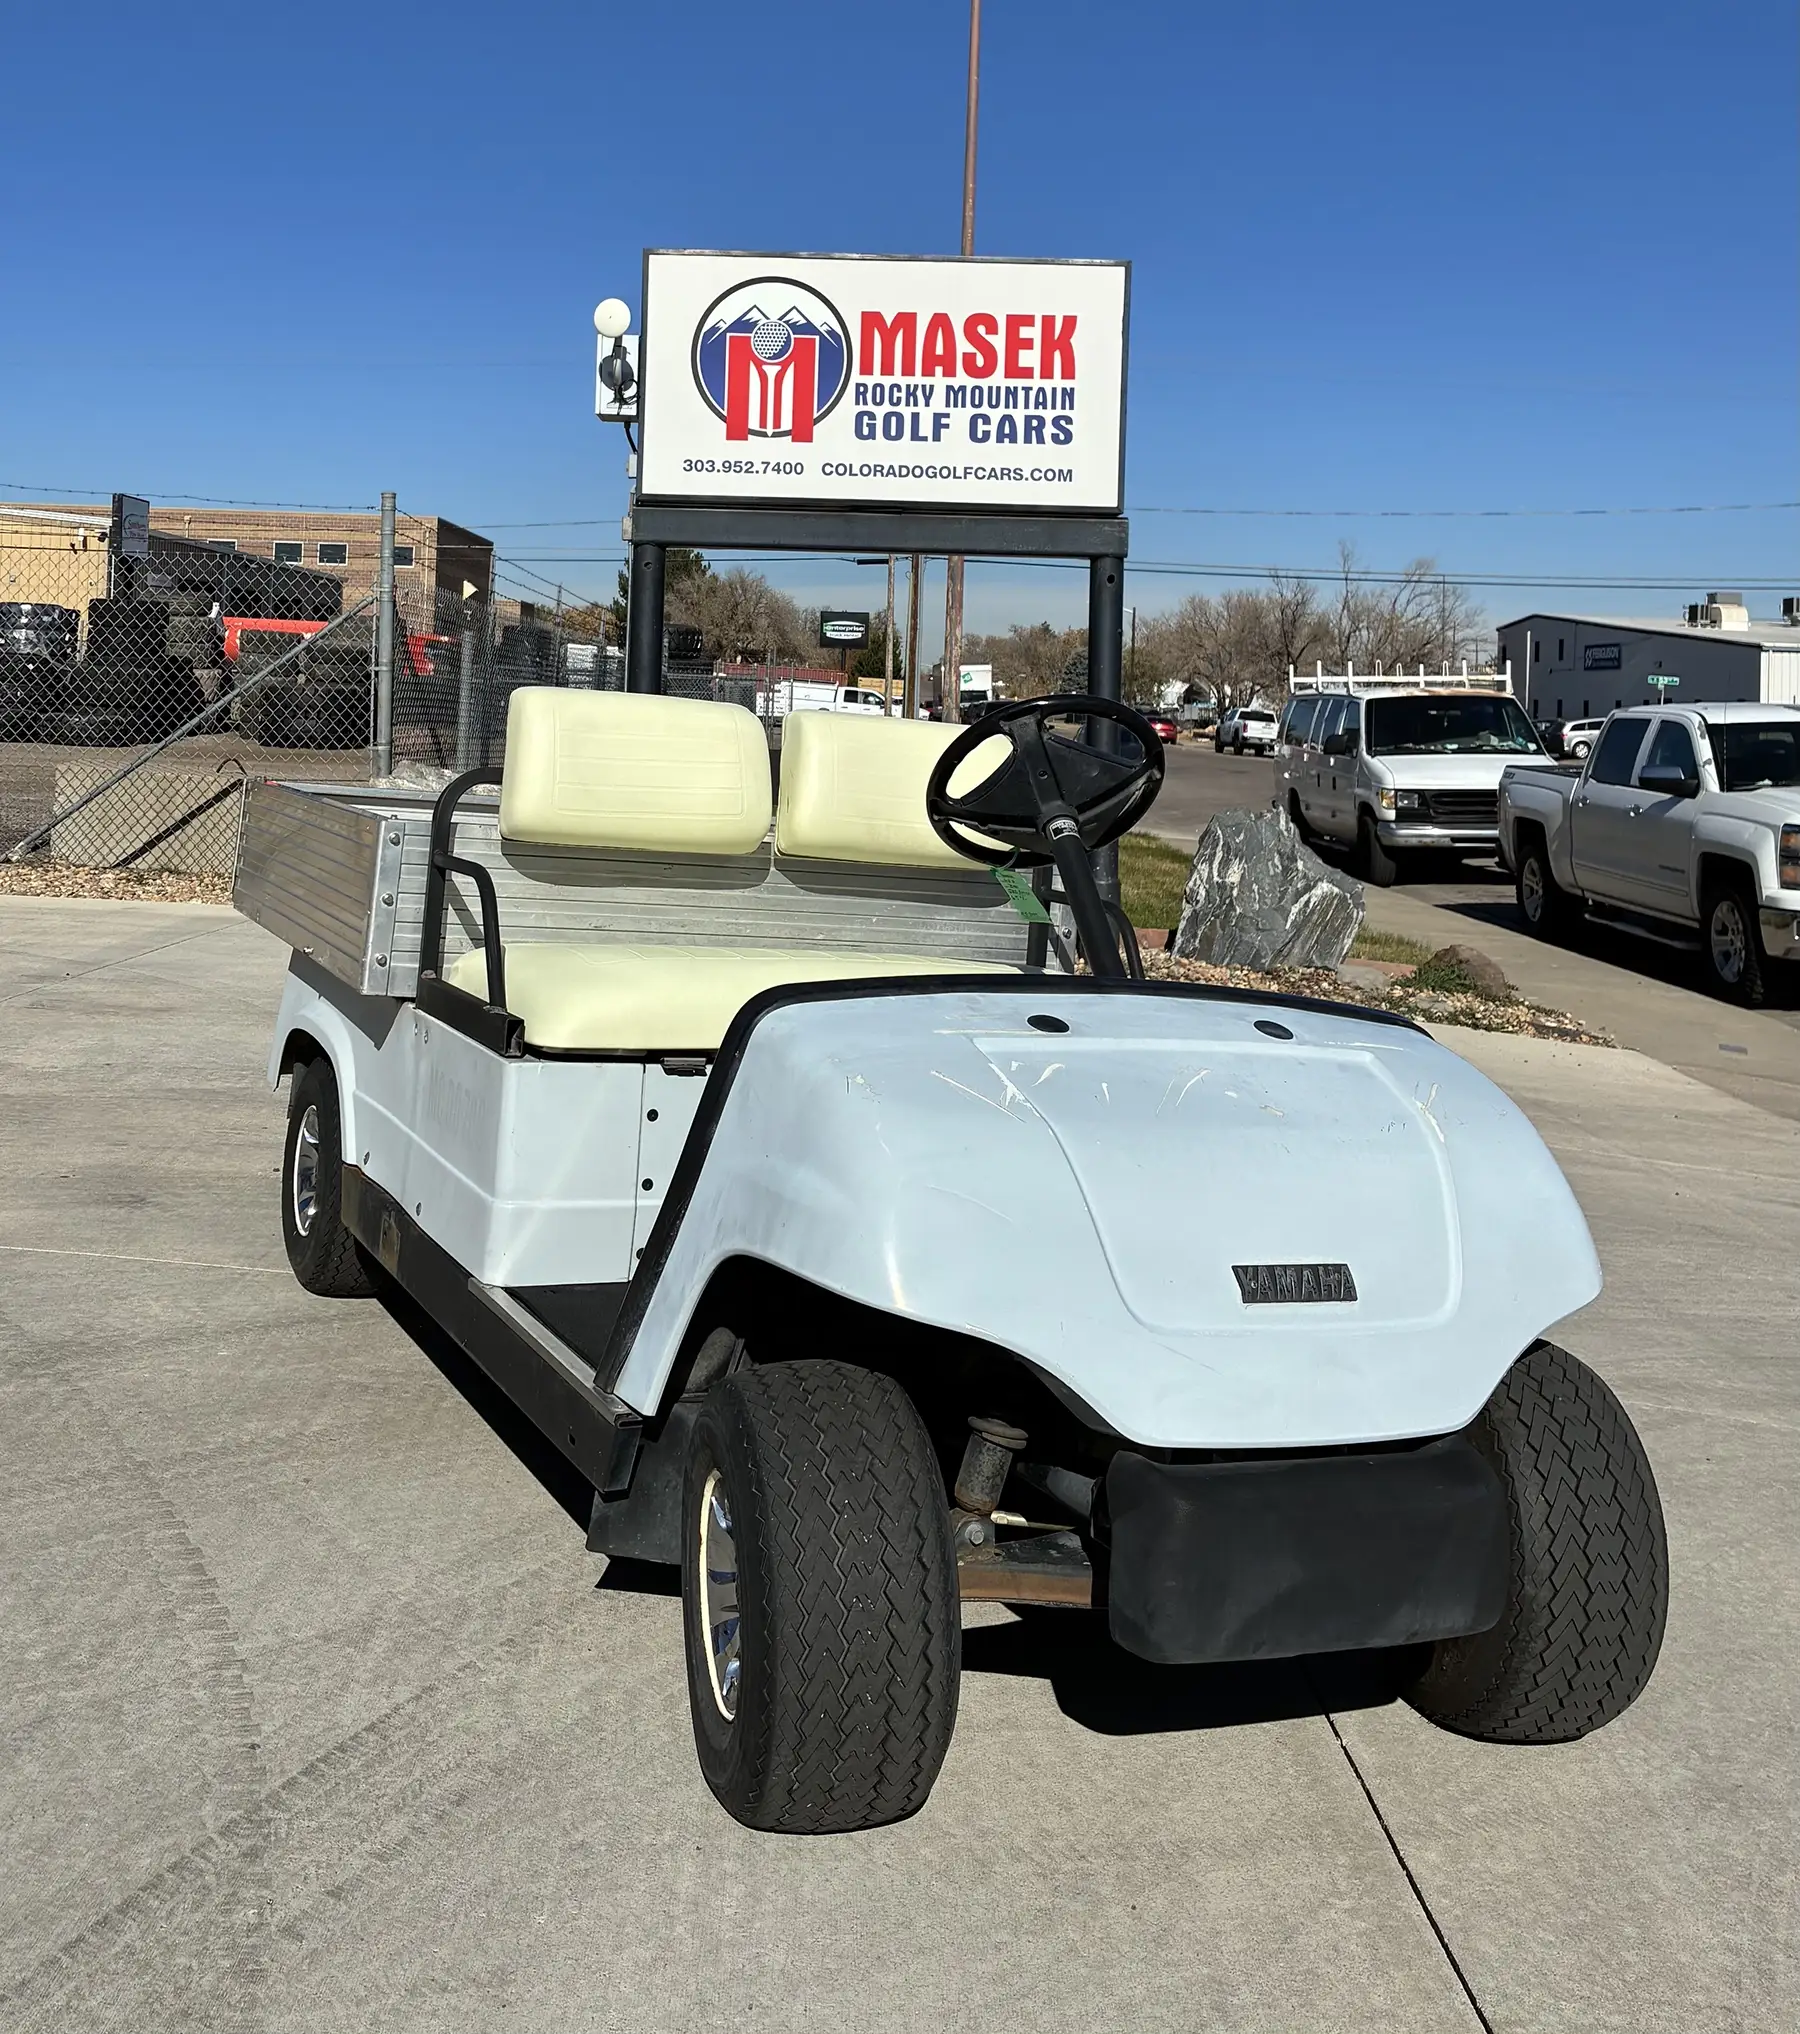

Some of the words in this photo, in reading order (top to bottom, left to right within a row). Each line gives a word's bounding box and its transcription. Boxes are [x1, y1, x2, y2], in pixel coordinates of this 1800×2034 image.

[859, 310, 1078, 380] MASEK
[855, 382, 935, 408] ROCKY
[945, 384, 1075, 411] MOUNTAIN
[854, 410, 951, 443] GOLF
[968, 413, 1074, 446] CARS
[682, 458, 805, 476] 303.952.7400
[820, 462, 1074, 483] COLORADOGOLFCARS.COM
[1235, 1265, 1357, 1301] YAMAHA
